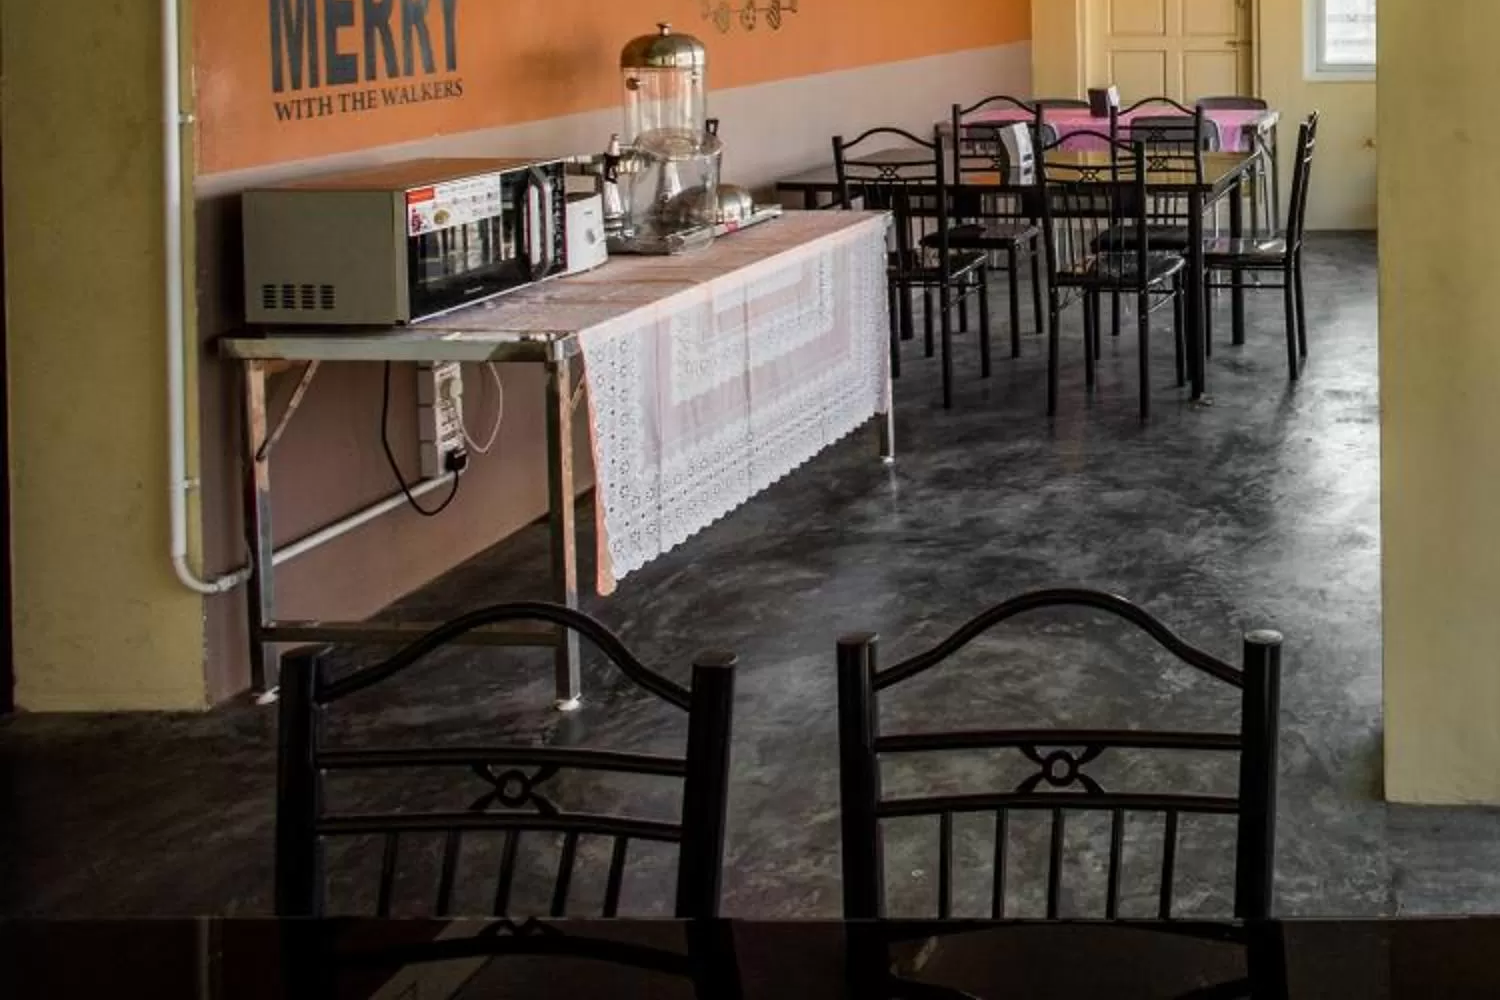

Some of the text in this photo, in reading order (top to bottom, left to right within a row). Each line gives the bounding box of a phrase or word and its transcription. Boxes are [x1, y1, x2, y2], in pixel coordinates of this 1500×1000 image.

[274, 78, 463, 121] WITH THE WALKERS
